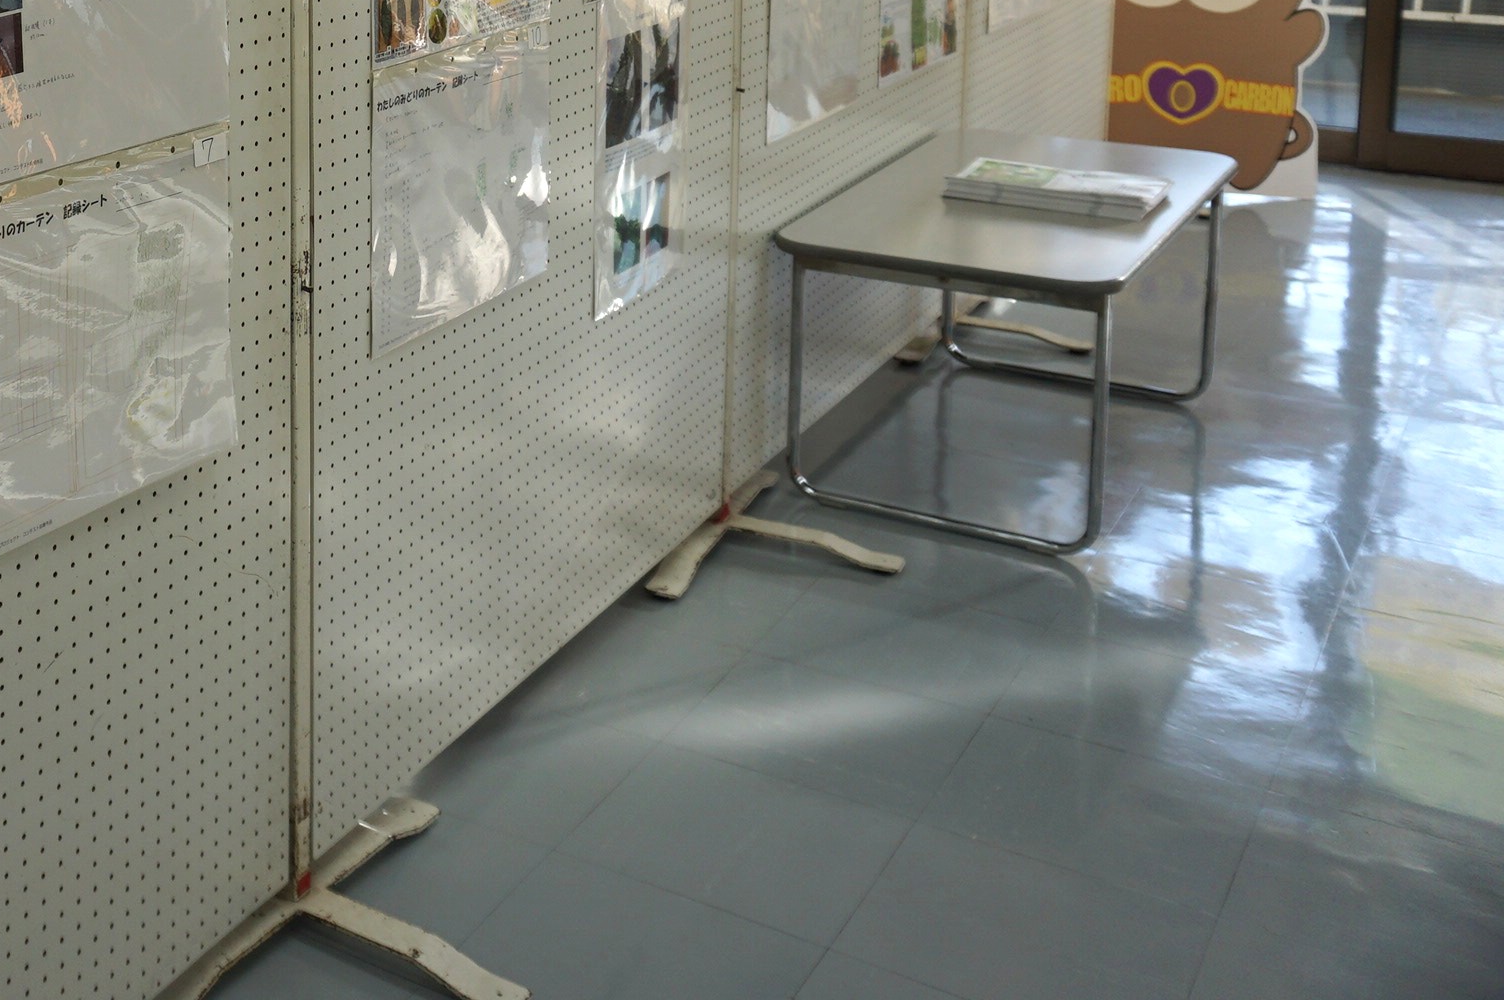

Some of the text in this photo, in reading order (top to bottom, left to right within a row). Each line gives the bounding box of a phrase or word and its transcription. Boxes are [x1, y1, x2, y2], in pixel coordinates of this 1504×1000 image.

[375, 81, 448, 114] わたしのみどりのカーテン
[1221, 79, 1295, 118] CARBON
[200, 138, 214, 163] 7
[62, 193, 108, 220] 記録シート
